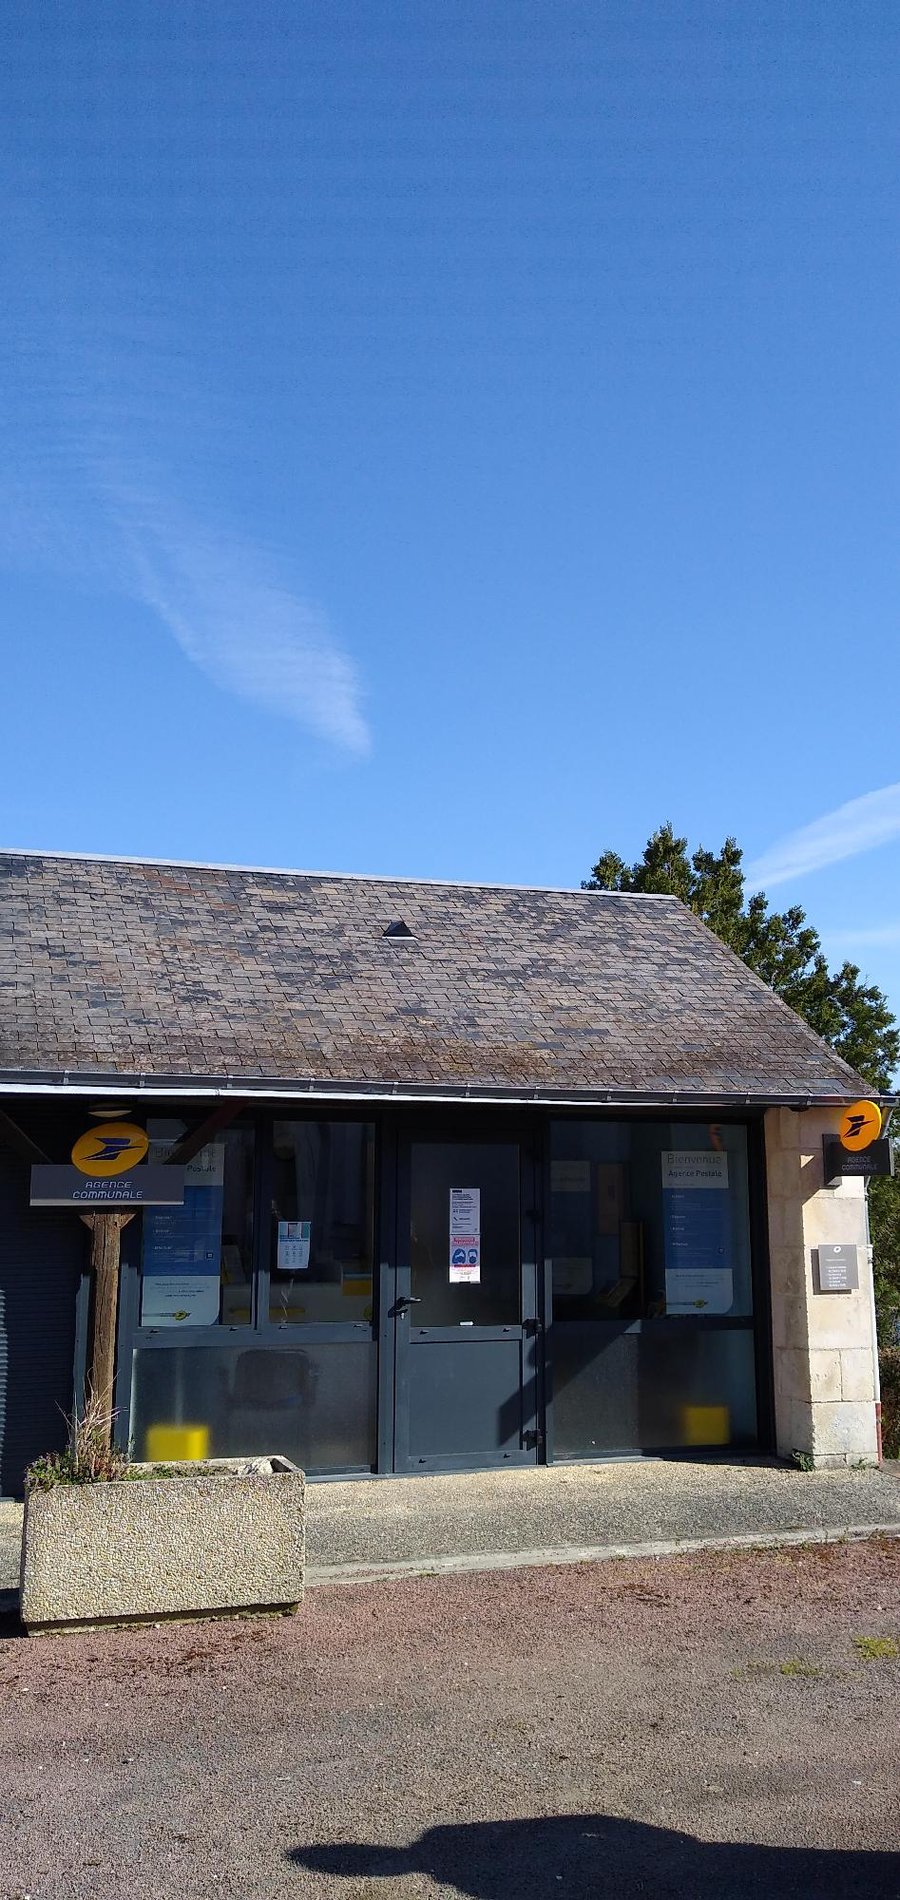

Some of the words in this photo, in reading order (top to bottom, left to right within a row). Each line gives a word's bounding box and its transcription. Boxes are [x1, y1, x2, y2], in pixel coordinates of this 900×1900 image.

[667, 1153, 721, 1164] Bienvenue
[847, 1155, 871, 1164] AGENCE
[186, 1165, 217, 1173] Postale
[668, 1169, 694, 1178] Agence
[695, 1169, 723, 1177] Postale
[85, 1181, 133, 1189] AGENCE
[72, 1190, 143, 1199] COMMUNALE
